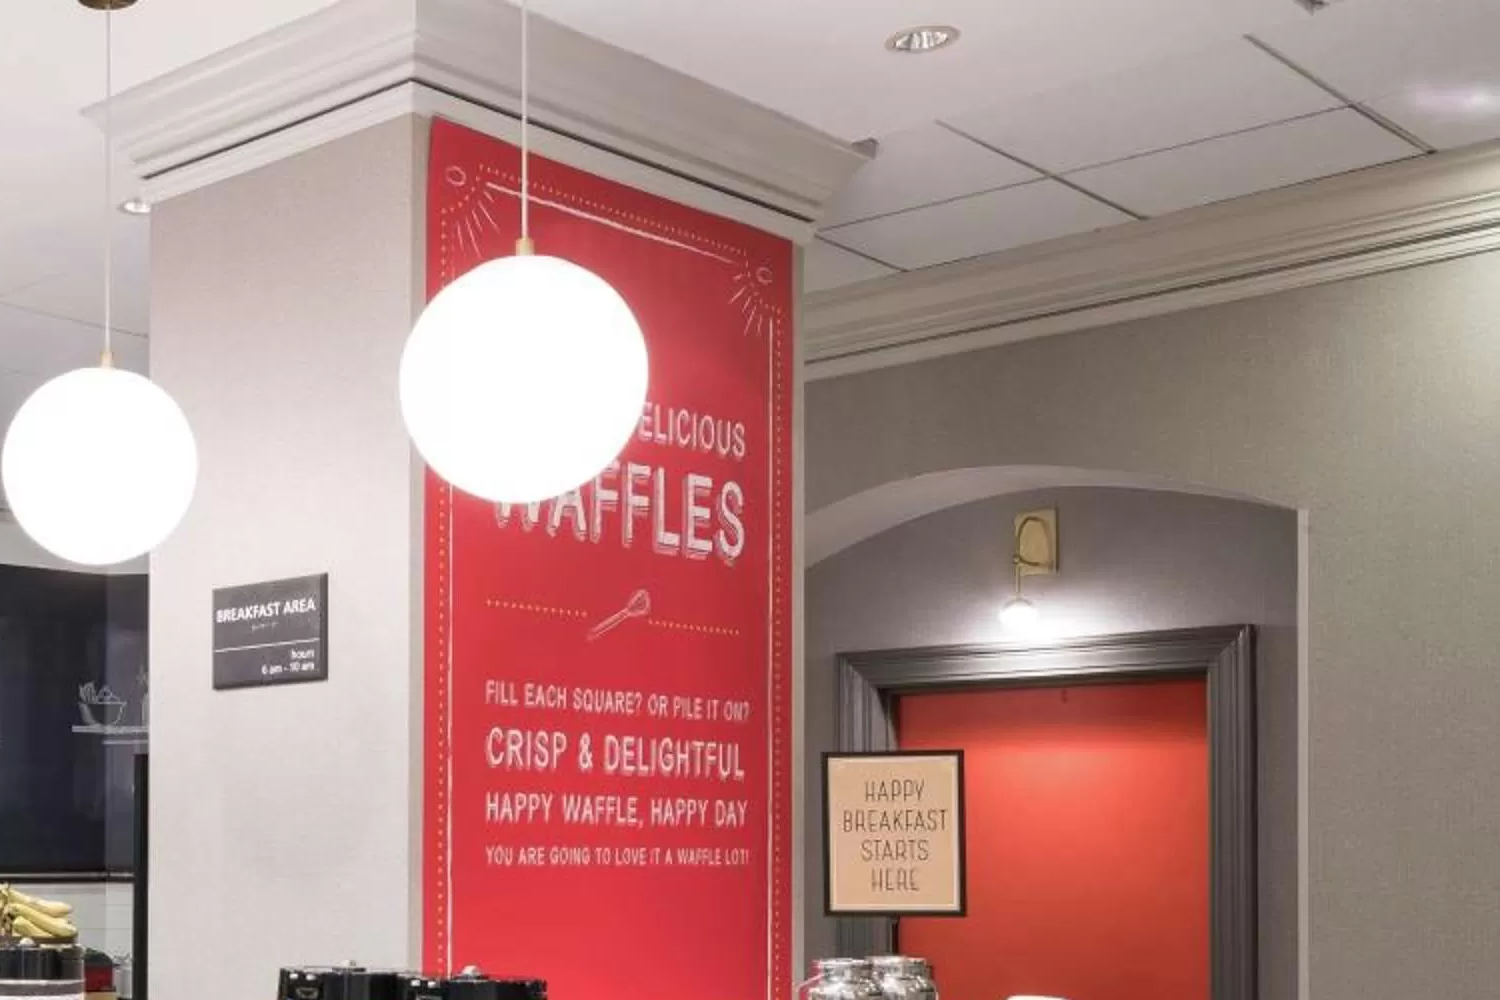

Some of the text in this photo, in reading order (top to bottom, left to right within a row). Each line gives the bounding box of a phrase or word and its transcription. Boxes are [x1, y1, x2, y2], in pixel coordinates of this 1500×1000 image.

[638, 401, 746, 459] ELICIOUS
[216, 597, 316, 623] BREAKFAST AREA
[486, 680, 518, 706] FILL
[524, 683, 567, 709] EACH
[573, 687, 643, 715] SQUARE?
[647, 693, 669, 717] OR
[673, 696, 702, 720] PILE
[707, 698, 719, 721] IT
[486, 727, 745, 778] CRISP & DELIGHTFUL
[865, 780, 925, 802] HAPPY
[485, 792, 748, 829] HAPPY WAFFLE, HAPPY DAY
[843, 809, 948, 833] BREAKFAST
[485, 845, 513, 866] YOU
[517, 846, 545, 866] ARE
[549, 846, 591, 866] GOING
[595, 847, 612, 866] TO
[614, 847, 647, 866] LOVE
[649, 847, 661, 865] IT
[664, 847, 673, 865] A
[677, 847, 721, 866] WAFFLE
[860, 839, 929, 861] STARTS
[871, 867, 920, 892] HERE
